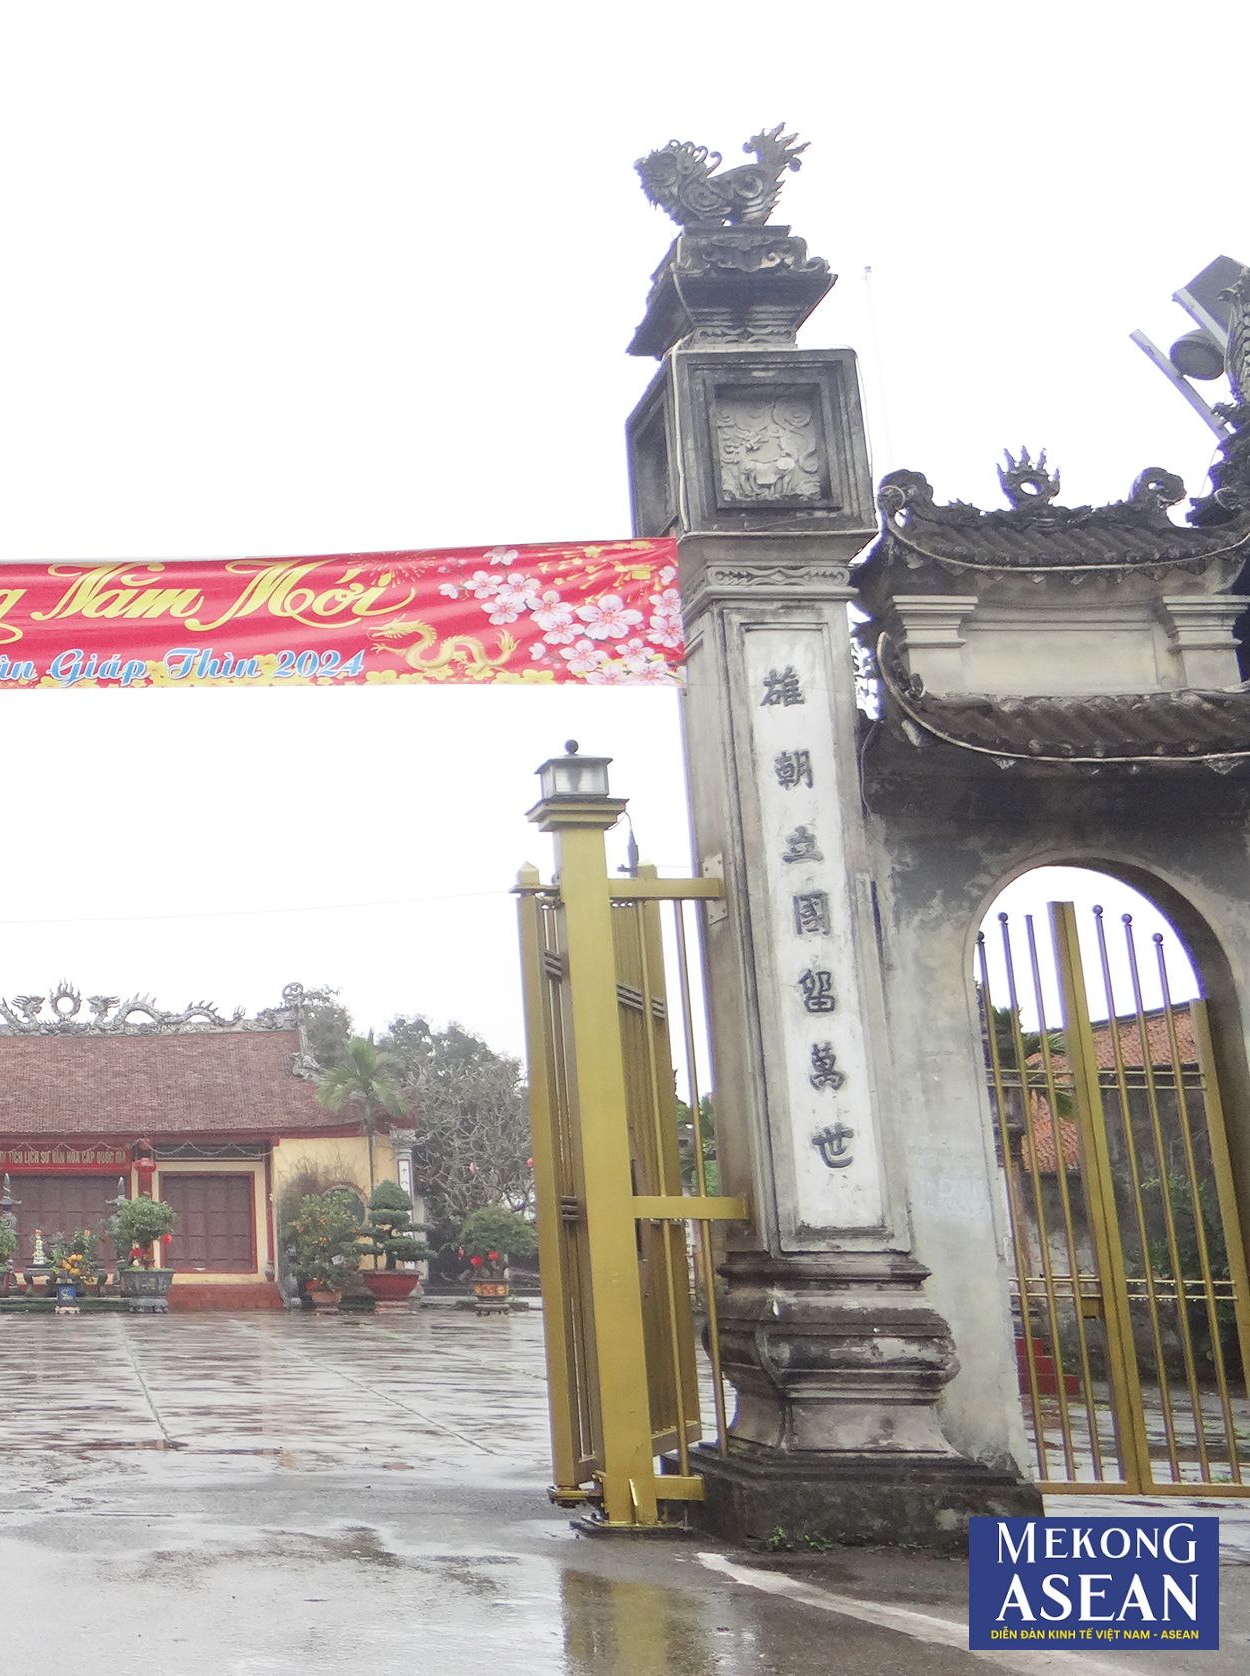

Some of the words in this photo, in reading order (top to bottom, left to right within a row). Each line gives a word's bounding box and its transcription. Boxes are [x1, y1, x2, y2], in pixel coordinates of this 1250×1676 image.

[30, 562, 204, 621] Năm
[184, 559, 416, 631] Mới
[46, 648, 149, 687] Giáp
[163, 647, 262, 680] Thìn
[271, 648, 366, 678] 2024
